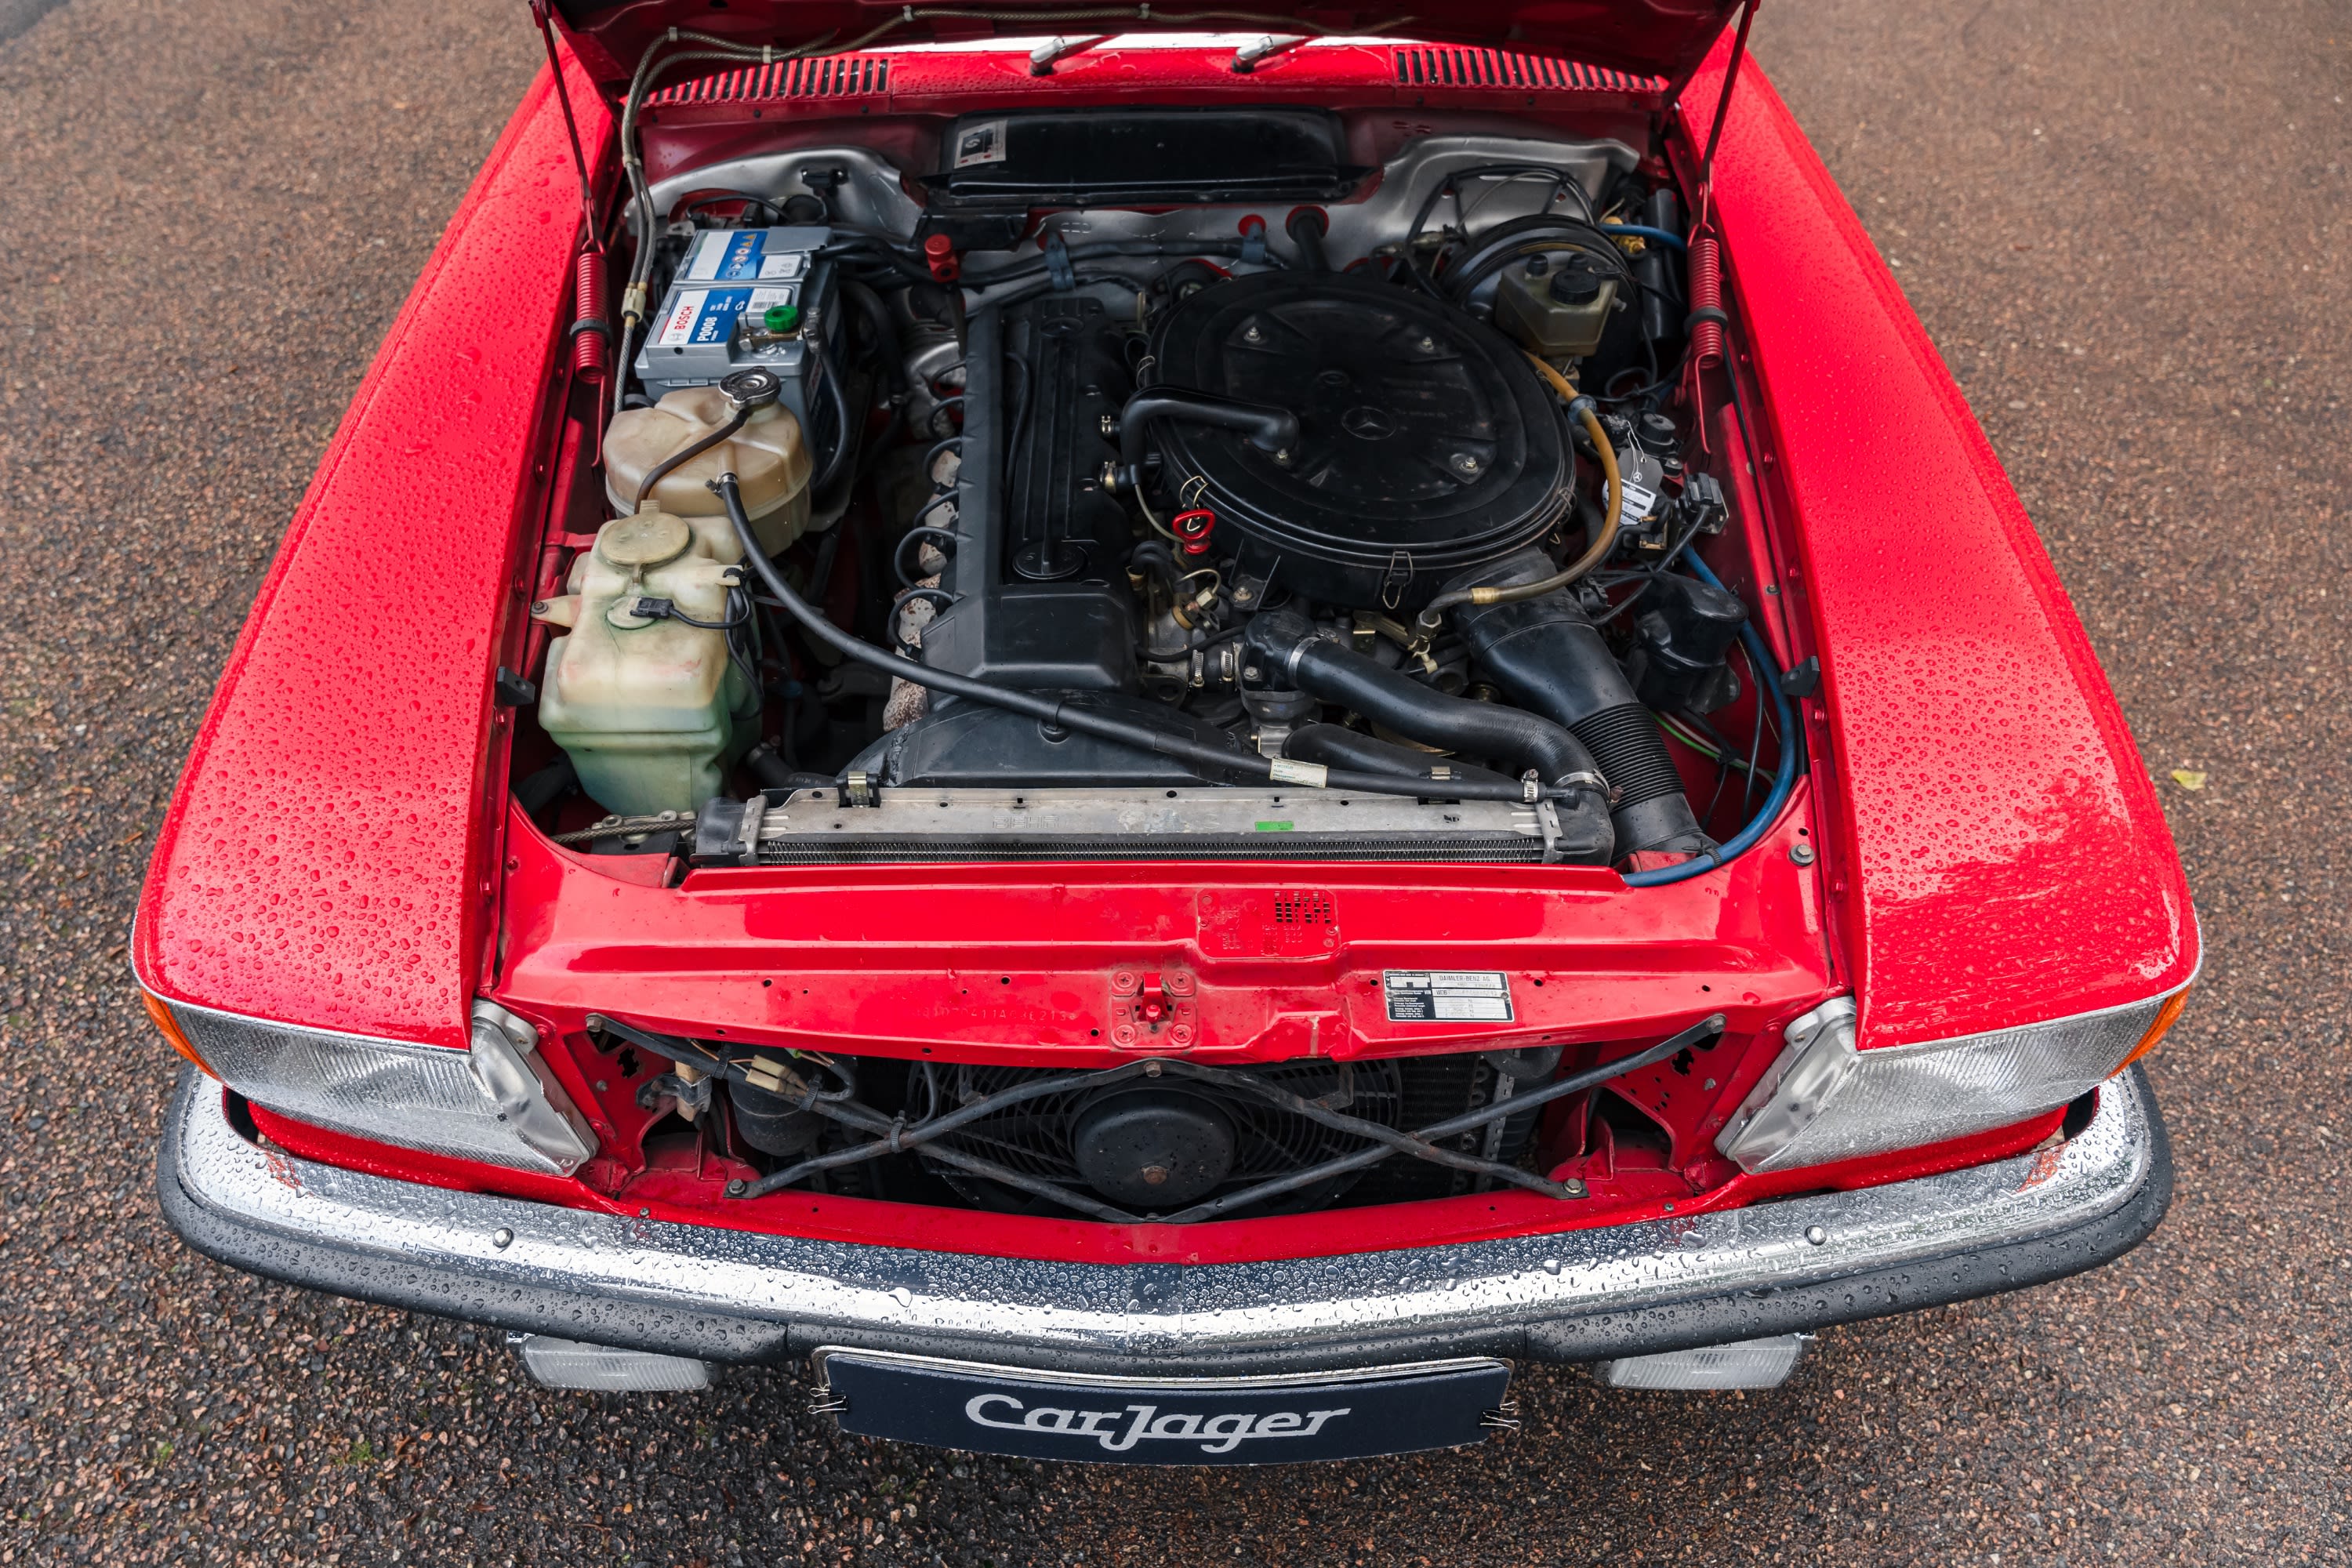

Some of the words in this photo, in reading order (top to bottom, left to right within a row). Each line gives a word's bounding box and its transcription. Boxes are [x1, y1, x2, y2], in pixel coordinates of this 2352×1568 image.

[674, 306, 695, 330] BOSCH
[696, 316, 718, 342] P0008
[991, 815, 1060, 829] BEHR
[965, 1394, 1351, 1454] CarJager
